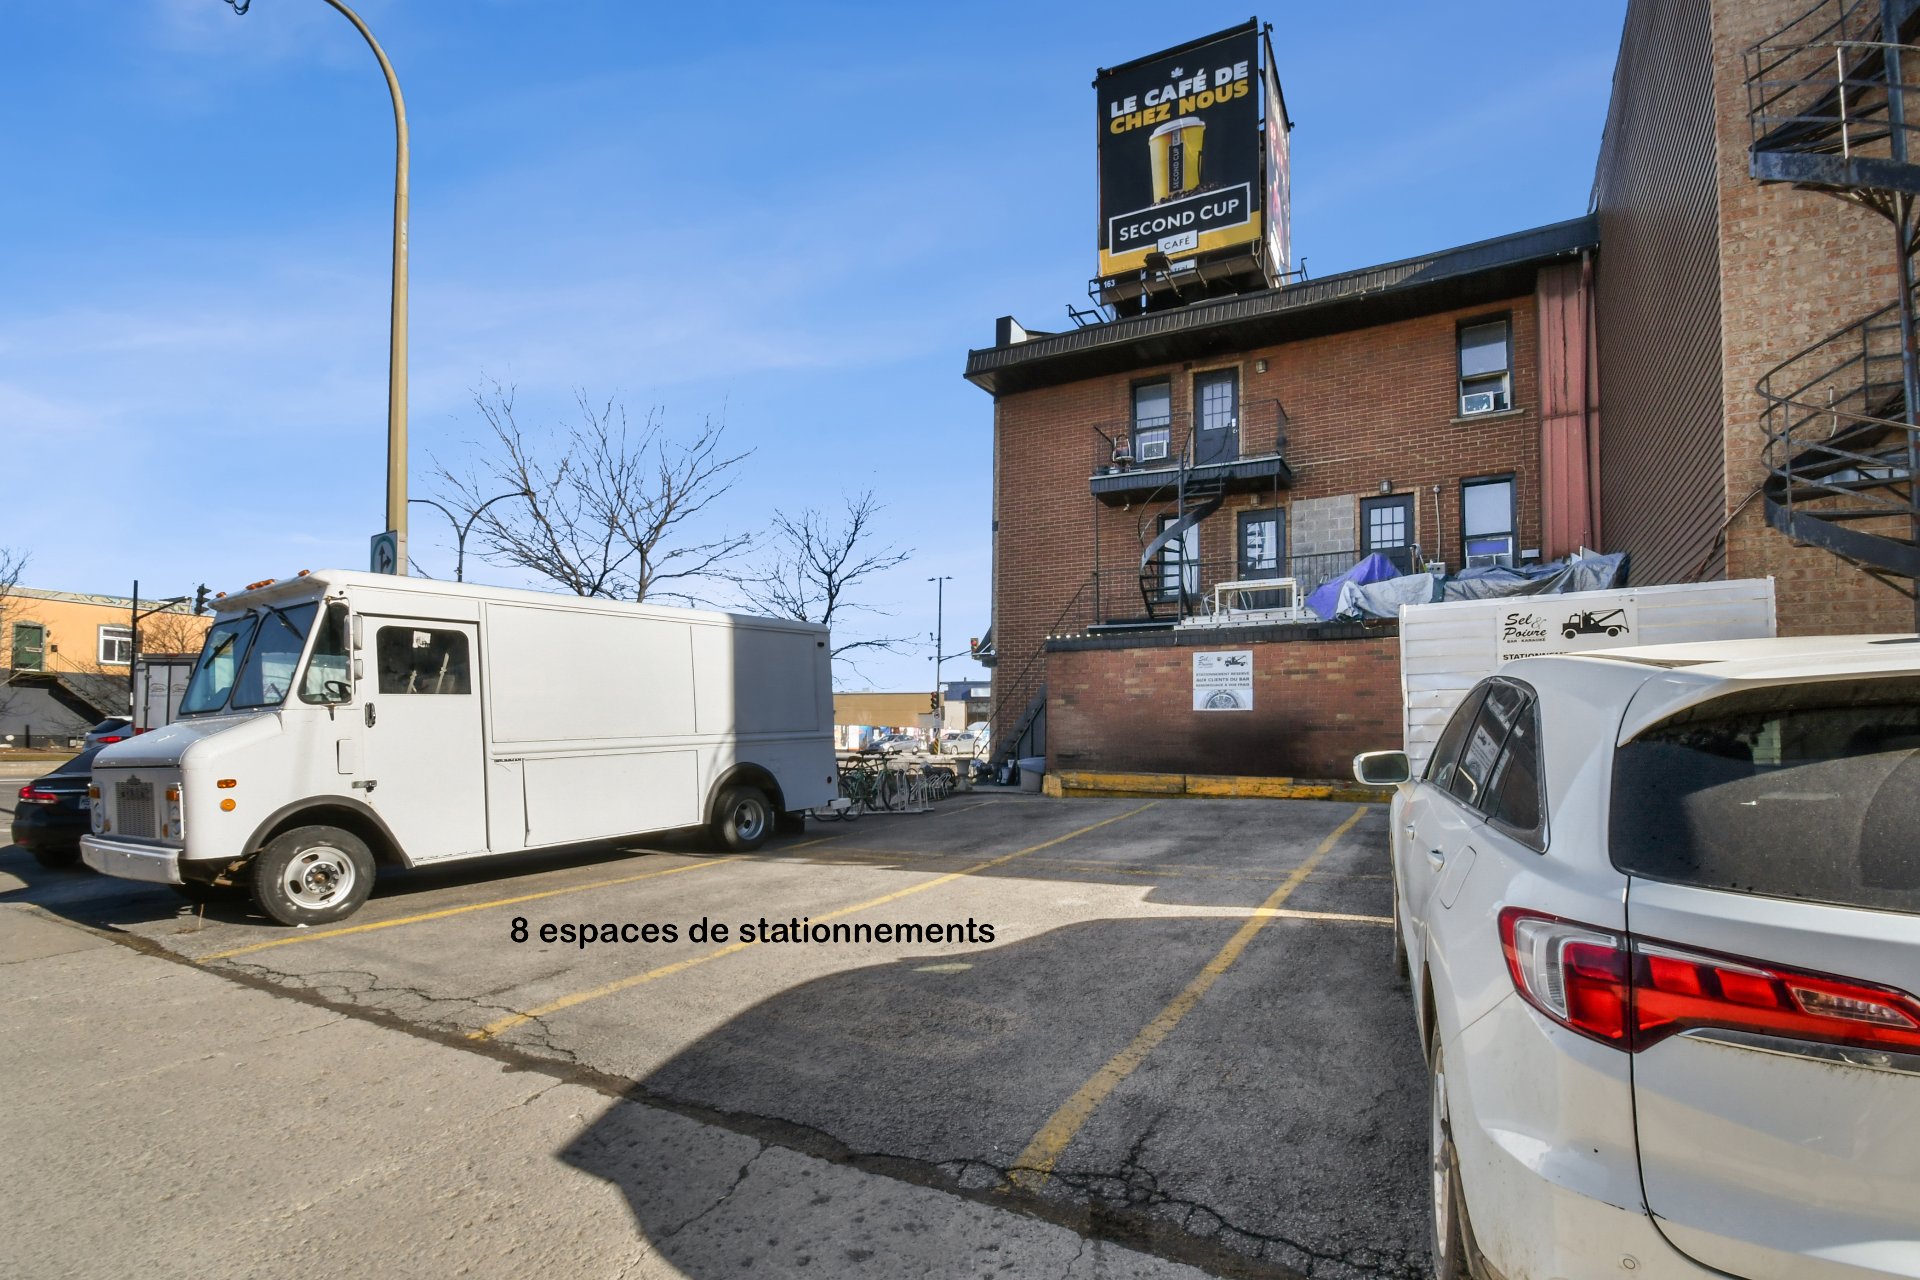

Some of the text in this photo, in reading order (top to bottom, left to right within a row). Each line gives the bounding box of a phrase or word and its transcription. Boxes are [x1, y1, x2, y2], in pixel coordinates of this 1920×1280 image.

[1110, 60, 1249, 118] LE CAFÉ DE
[1110, 79, 1249, 135] CHEZ NOUS
[1119, 198, 1239, 241] SECOND CUP
[1164, 236, 1190, 250] CAFÉ
[1503, 626, 1547, 640] Poivre
[1504, 613, 1532, 626] Sel
